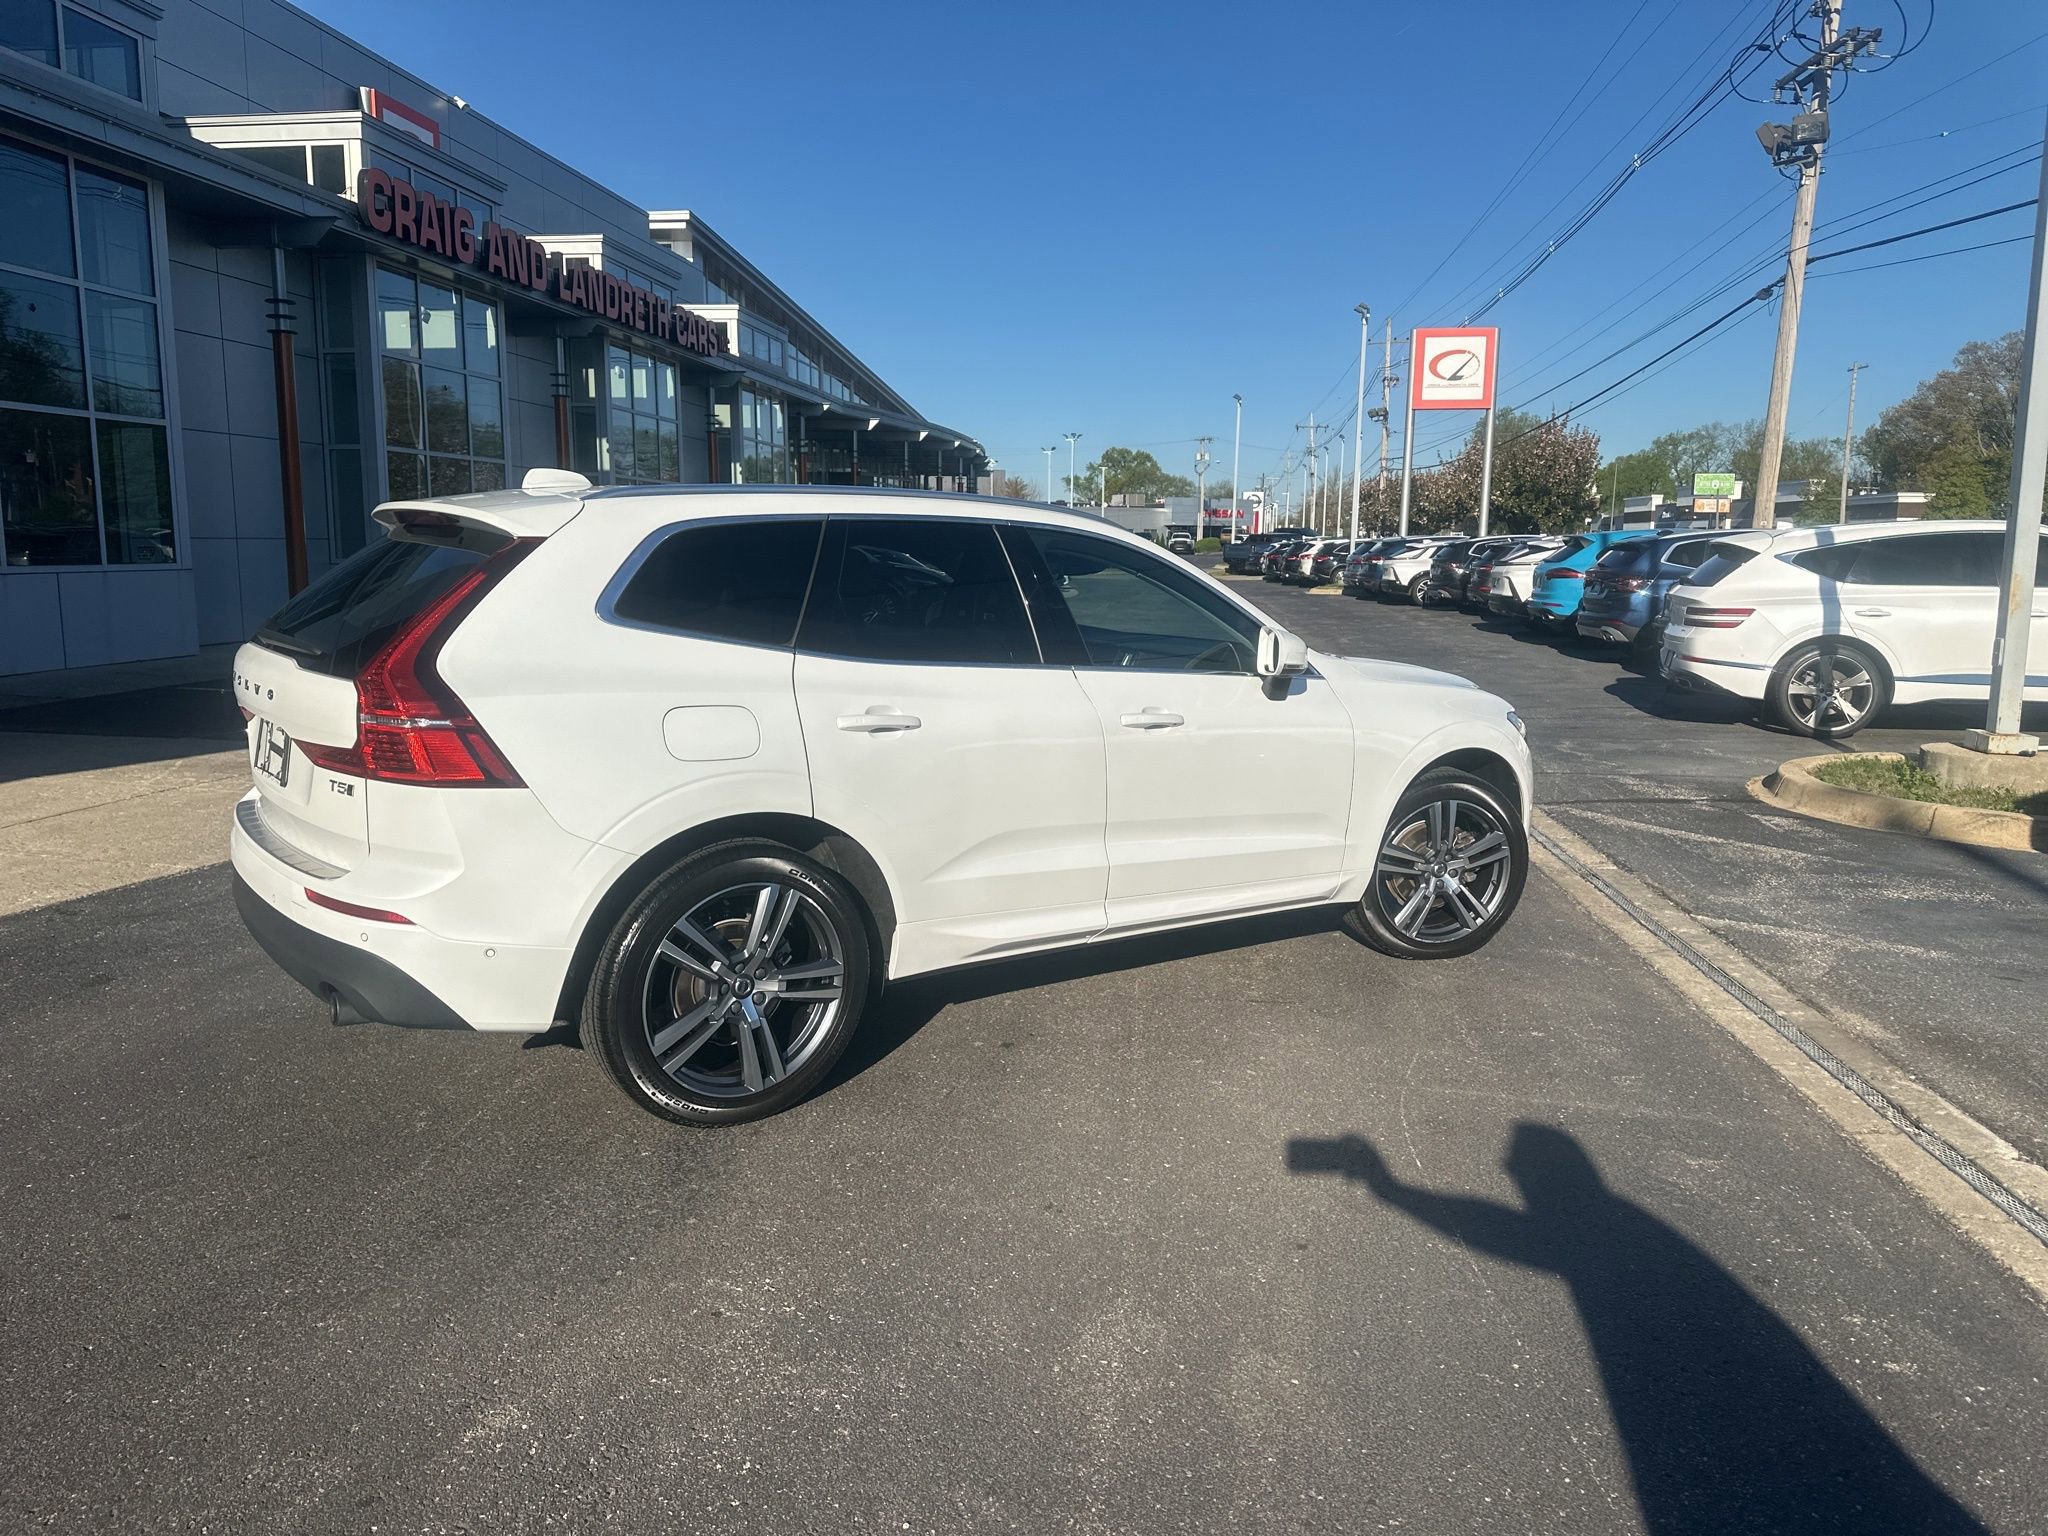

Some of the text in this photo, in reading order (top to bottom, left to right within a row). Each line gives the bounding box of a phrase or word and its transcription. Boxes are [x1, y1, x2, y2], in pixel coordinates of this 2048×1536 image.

[364, 166, 476, 264] CRAIG
[487, 220, 548, 292] AND
[558, 258, 670, 340] LANDRETH
[675, 306, 719, 358] CARS
[1204, 508, 1245, 519] NISSAN
